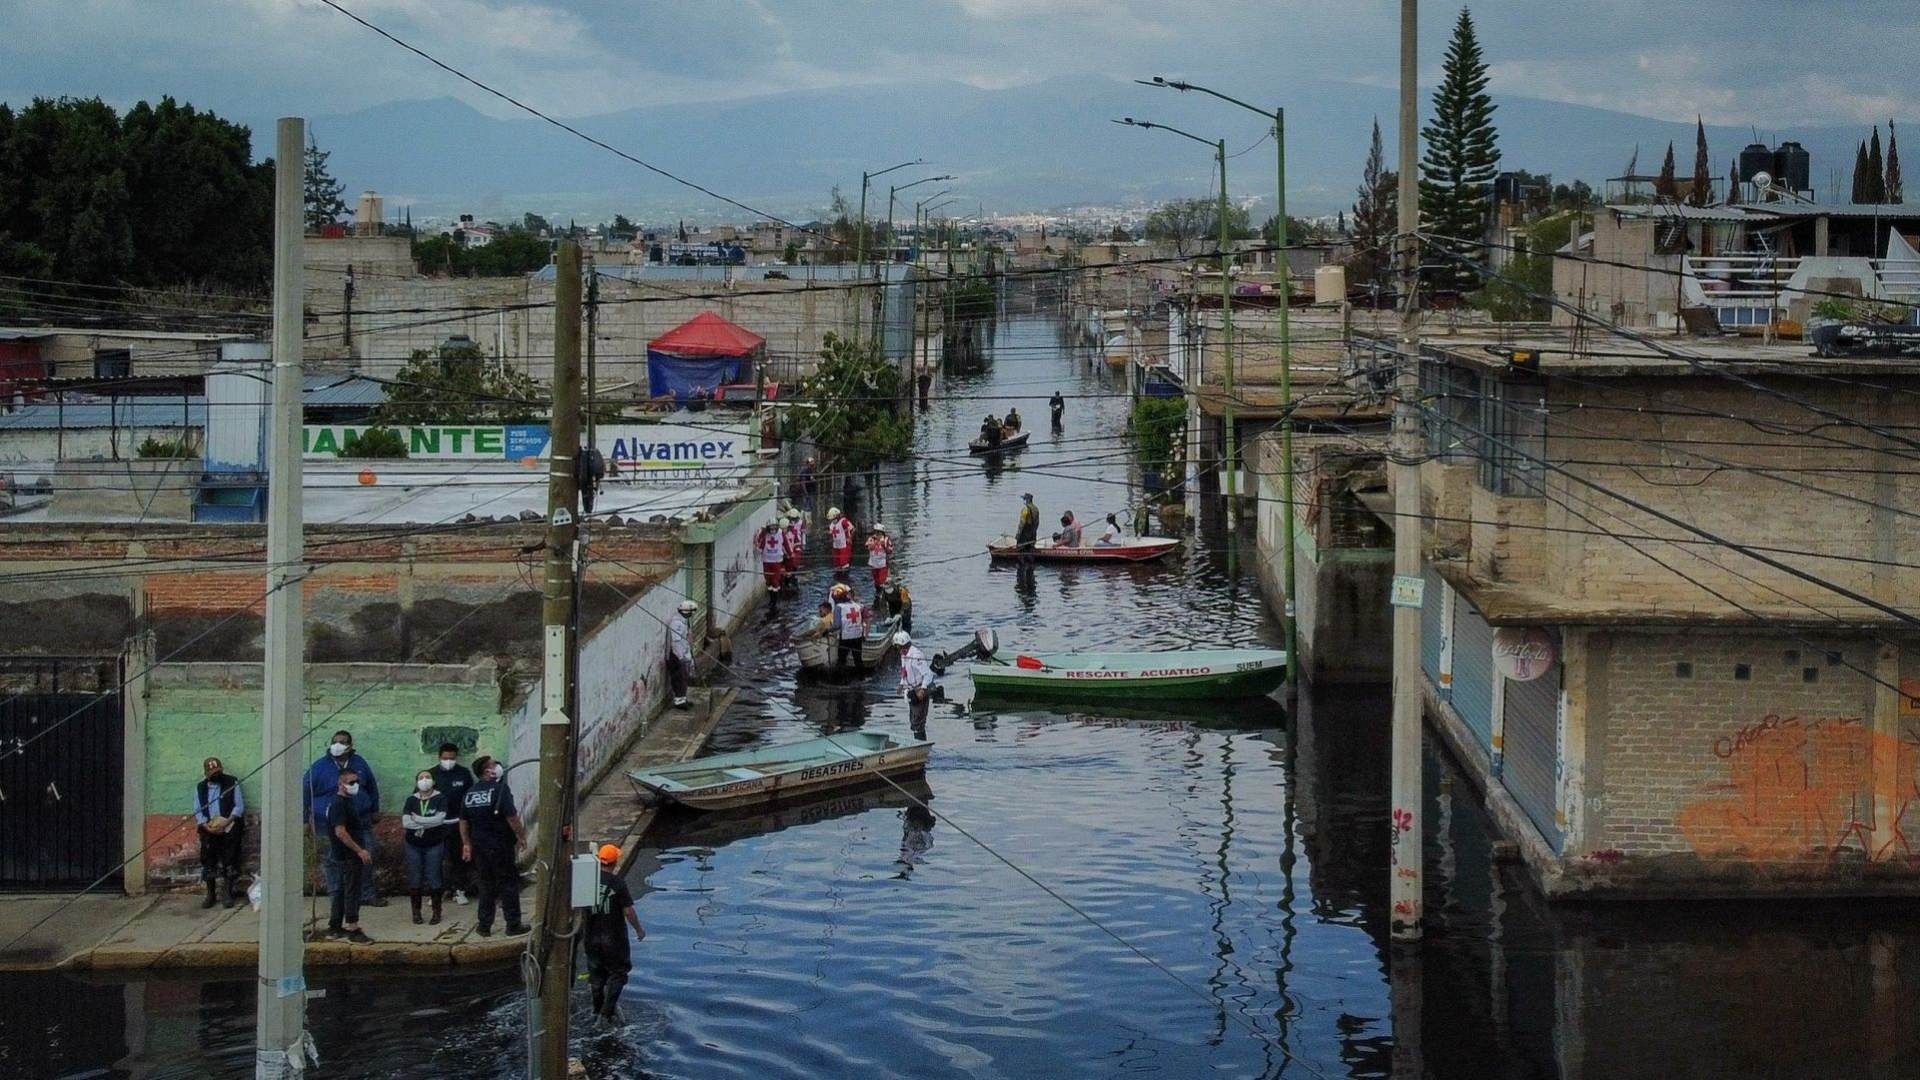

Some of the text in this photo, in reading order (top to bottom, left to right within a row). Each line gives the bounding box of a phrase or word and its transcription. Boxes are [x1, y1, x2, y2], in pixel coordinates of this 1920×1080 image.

[611, 436, 735, 460] Alvamex
[1066, 660, 1263, 679] RESCATE ACUATICO SUEM
[800, 760, 864, 781] DESASTRES
